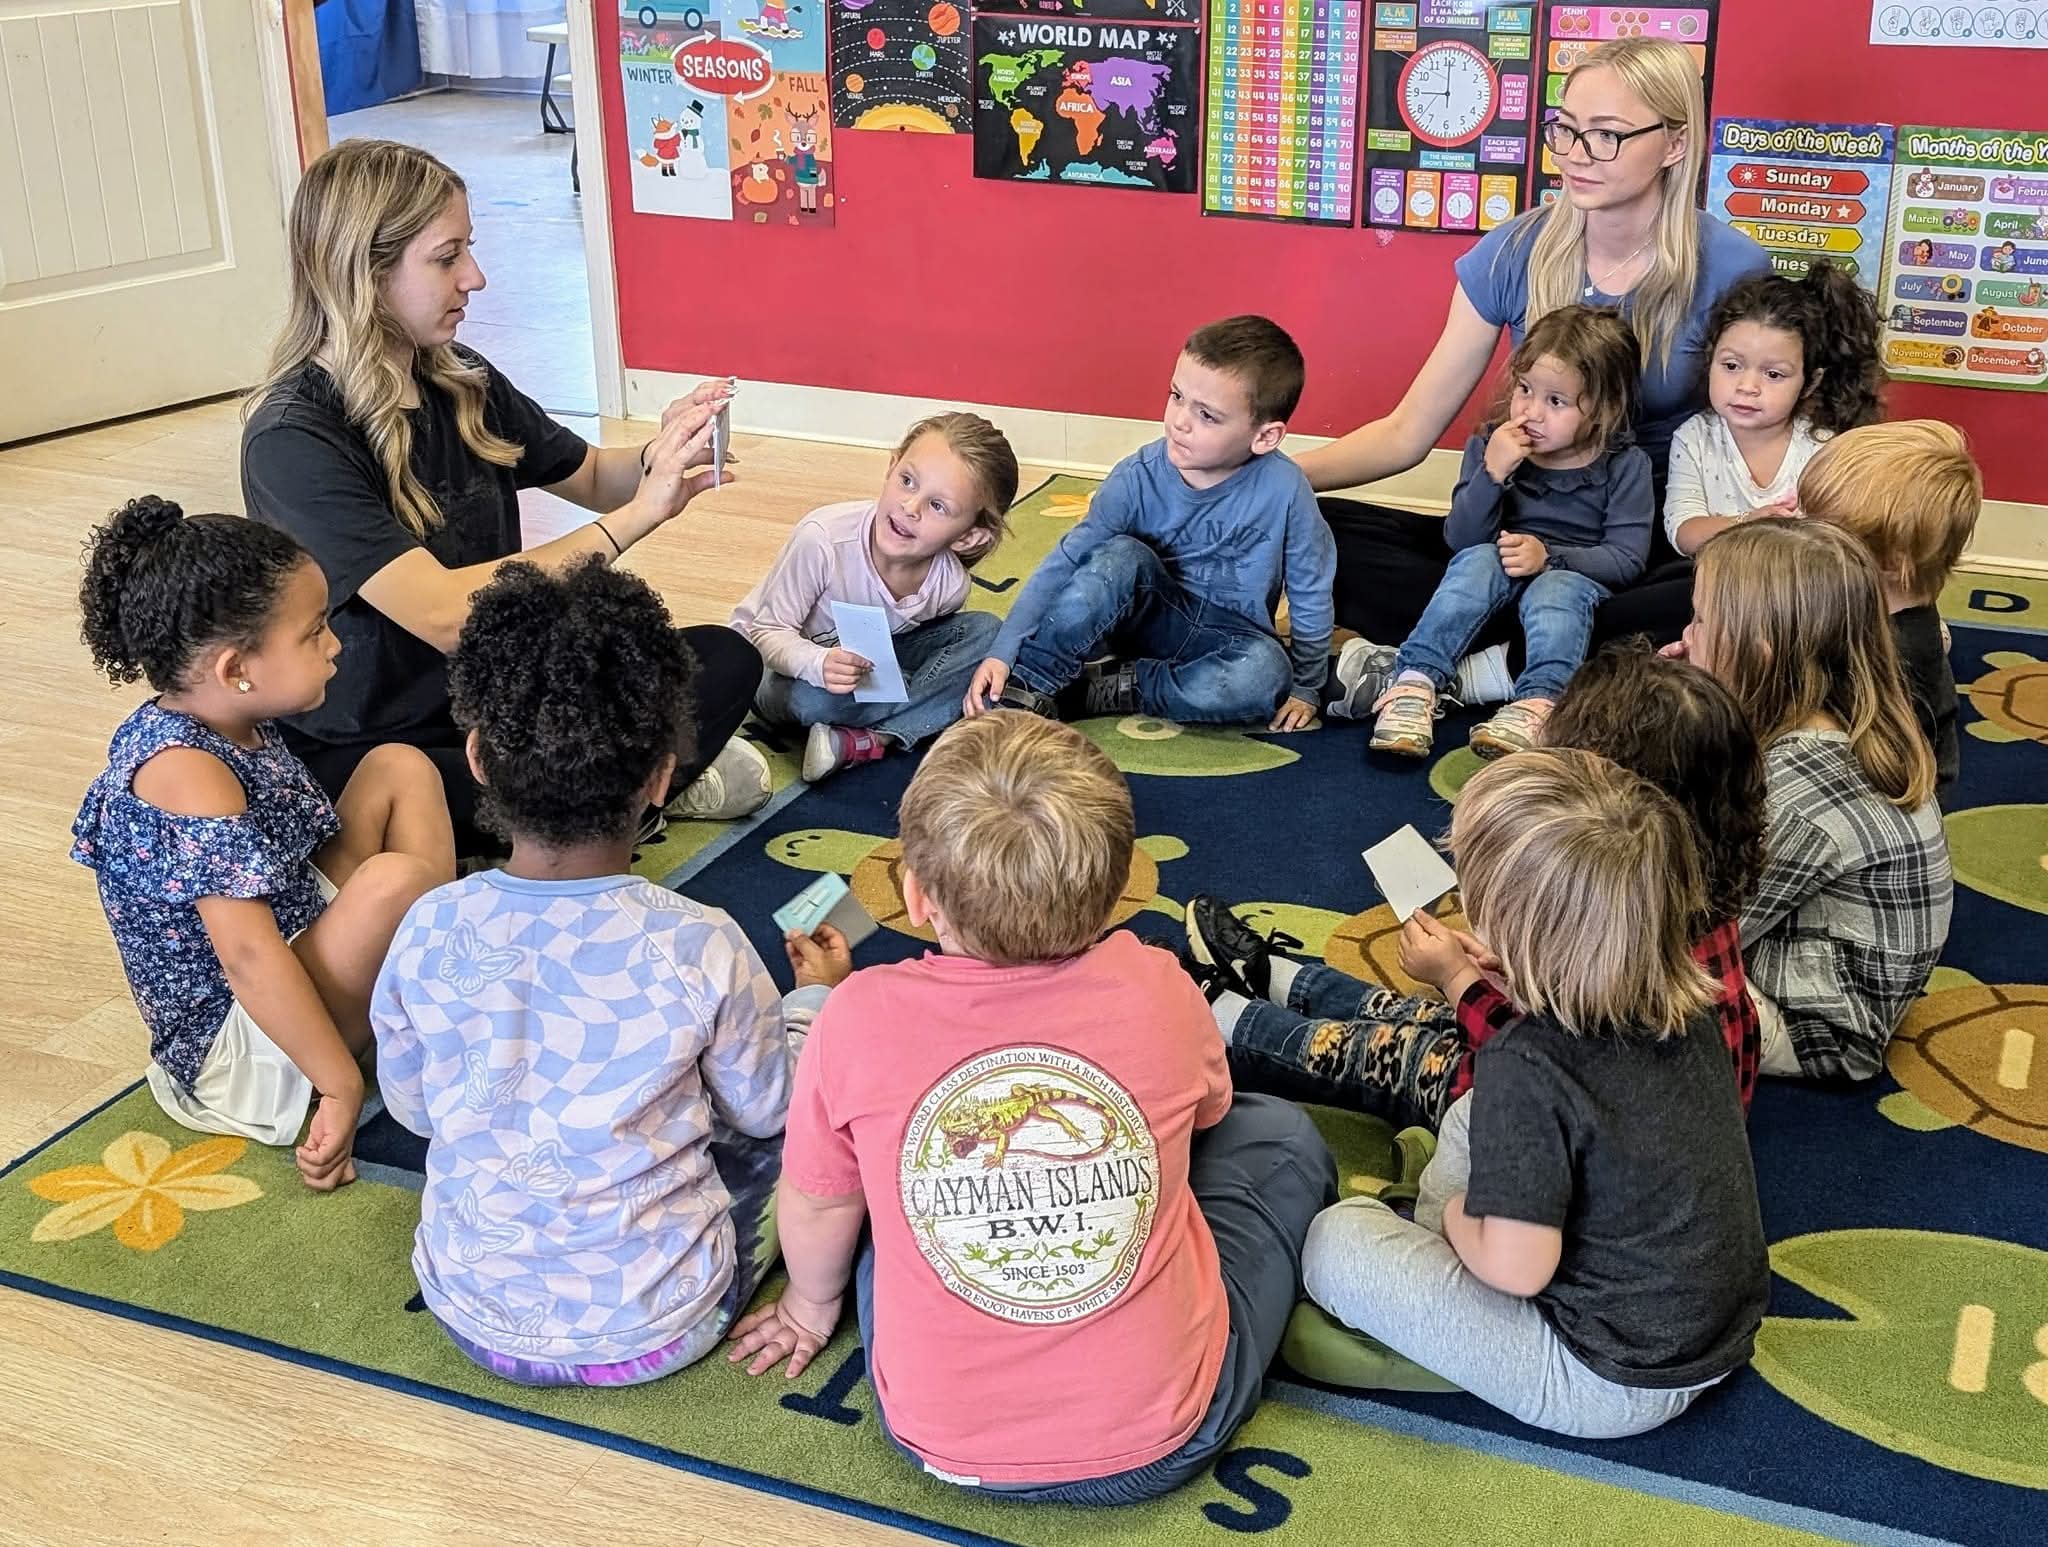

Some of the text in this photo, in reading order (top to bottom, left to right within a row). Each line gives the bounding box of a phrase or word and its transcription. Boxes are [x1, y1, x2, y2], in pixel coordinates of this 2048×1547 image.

[1230, 3, 1236, 12] 2
[1243, 3, 1250, 13] 3
[1258, 4, 1265, 13] 4
[1273, 5, 1279, 14] 5
[1288, 6, 1294, 15] 6
[1303, 6, 1309, 16] 7
[1318, 7, 1325, 16] 8
[1333, 8, 1340, 17] 9
[1347, 9, 1357, 18] 10
[1562, 8, 1588, 16] PENNY
[1018, 23, 1151, 50] WORLD MAP
[1215, 24, 1357, 40] 11 12 13 14 15 16 17 18 19 20
[936, 36, 961, 44] JUPITER
[1560, 42, 1587, 50] NICKEL
[1213, 46, 1357, 62] 21 22 23 24 25 26 27 28 29 30
[1431, 61, 1440, 71] 11
[1444, 57, 1456, 67] 12
[1462, 62, 1468, 71] 1
[683, 54, 763, 82] SEASONS
[627, 67, 673, 85] WINTER
[915, 71, 934, 79] EARTH
[1212, 67, 1356, 84] 31 32 33 34 35 36 37 38 39 40
[1419, 72, 1430, 81] 10
[1473, 74, 1479, 83] 2
[789, 76, 819, 94] FALL
[1110, 76, 1132, 86] ASIA
[1504, 80, 1526, 89] WHAT
[1414, 88, 1420, 97] 9
[1477, 91, 1483, 100] 3
[1506, 89, 1524, 97] TIME
[1506, 97, 1522, 106] IS IT
[1059, 102, 1094, 113] AFRICA
[1417, 104, 1424, 113] 8
[1470, 106, 1476, 115] 4
[1502, 105, 1525, 114] NOW?
[1428, 114, 1435, 123] 7
[1460, 116, 1466, 125] 5
[1443, 120, 1449, 130] 6
[1727, 127, 1880, 153] Days of the Week
[1144, 146, 1177, 156] AUSTRALIA
[1912, 137, 1976, 157] Months
[1981, 140, 2000, 157] of
[2005, 143, 2033, 161] the
[1765, 168, 1832, 190] Sunday
[1938, 181, 1979, 194] January
[2018, 186, 2048, 196] Febru
[1760, 198, 1831, 219] Monday
[1908, 214, 1939, 224] March
[1993, 220, 2018, 230] April
[1756, 225, 1829, 247] Tuesday
[1949, 251, 1969, 262] May
[2023, 256, 2048, 266] June
[1901, 282, 1922, 292] July
[1982, 288, 2018, 299] August
[1914, 316, 1965, 329] September
[2002, 323, 2044, 334] October
[1891, 349, 1939, 359] November
[1971, 354, 2020, 366] December
[1968, 589, 2030, 613] D
[930, 1078, 959, 1105] CLASS
[958, 1052, 1036, 1082] DESTINATION
[1039, 1052, 1071, 1070] WITH
[1072, 1064, 1081, 1074] A
[1082, 1068, 1109, 1090] RICH
[911, 1156, 1152, 1217] CAYMAN ISLANDS
[1002, 1264, 1085, 1282] SINCE 1503
[948, 1281, 973, 1298] AND
[973, 1294, 1009, 1314] ENJOY
[1010, 1307, 1055, 1321] HAVENS
[1057, 1306, 1073, 1319] OF
[1073, 1290, 1112, 1314] WHITE
[1110, 1266, 1132, 1295] SAND
[1201, 1446, 1313, 1534] S
